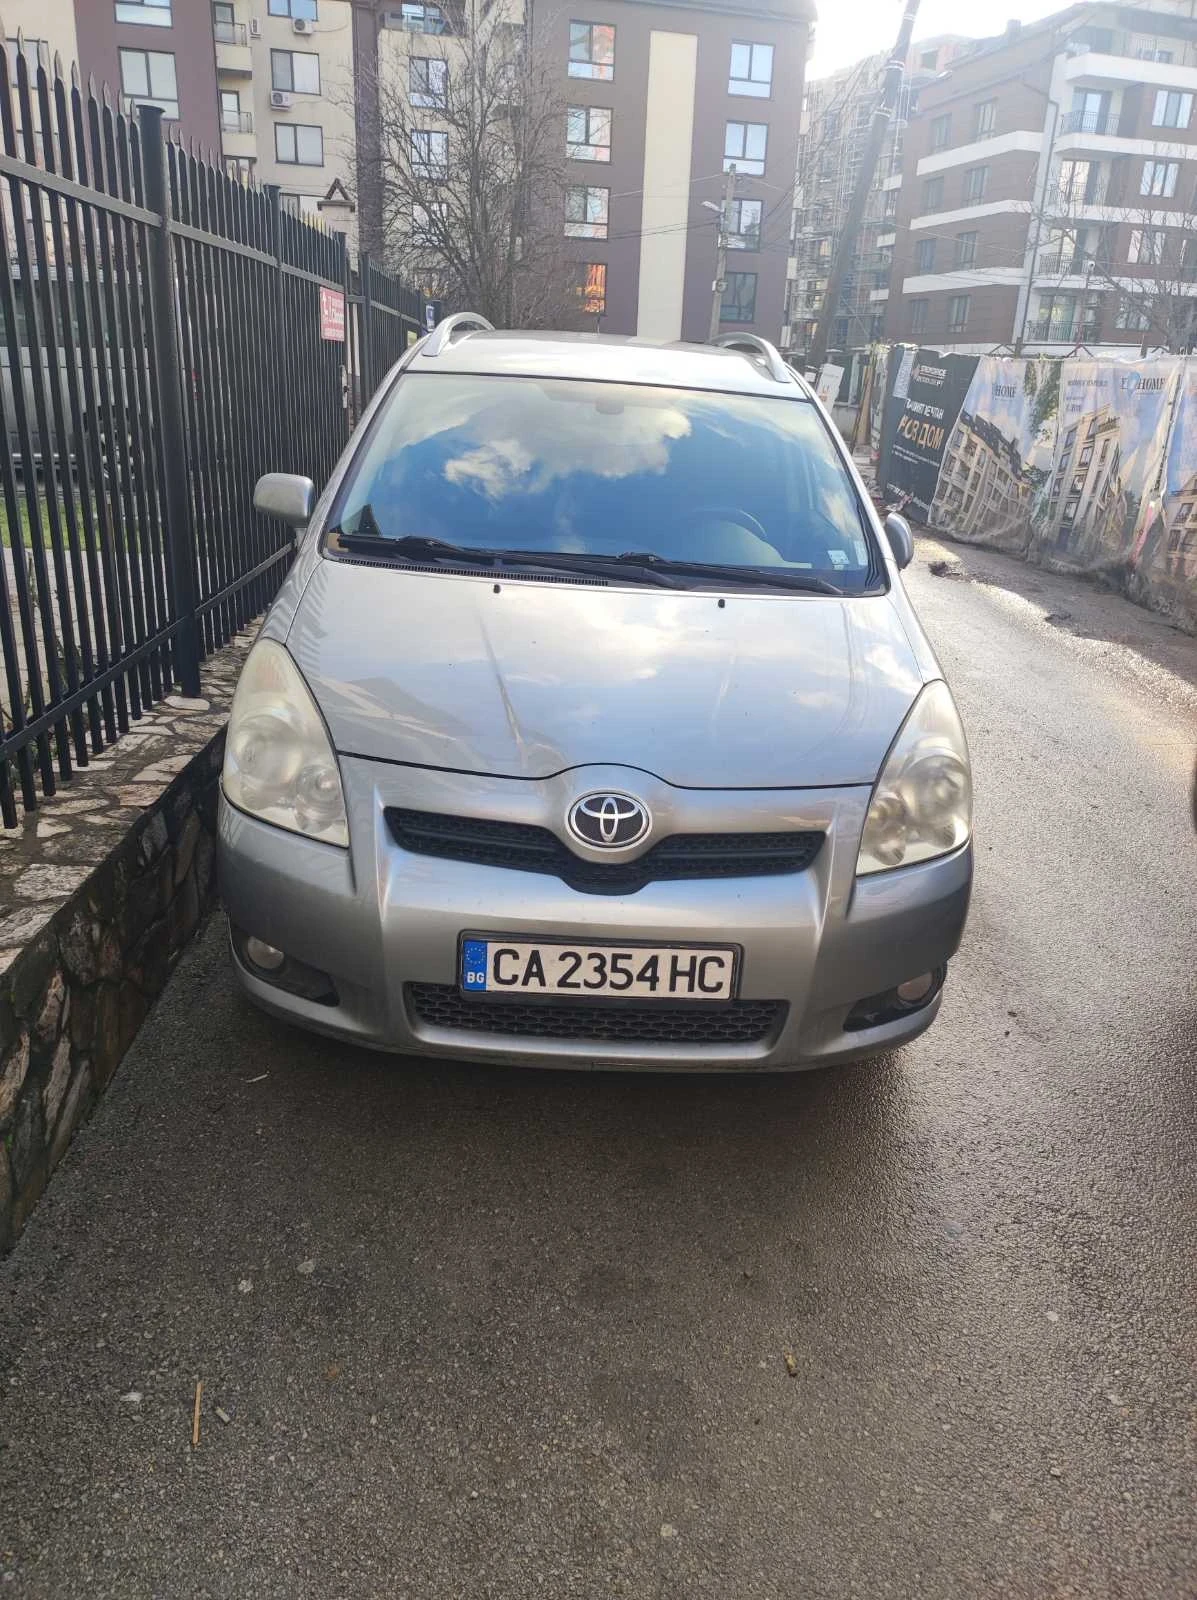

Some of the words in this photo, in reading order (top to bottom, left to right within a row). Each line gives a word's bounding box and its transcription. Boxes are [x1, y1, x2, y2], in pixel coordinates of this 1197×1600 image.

[917, 422, 945, 450] ДОМ
[467, 972, 485, 984] BG
[493, 948, 546, 987] CA
[557, 951, 660, 992] 2354
[668, 954, 725, 993] HC
